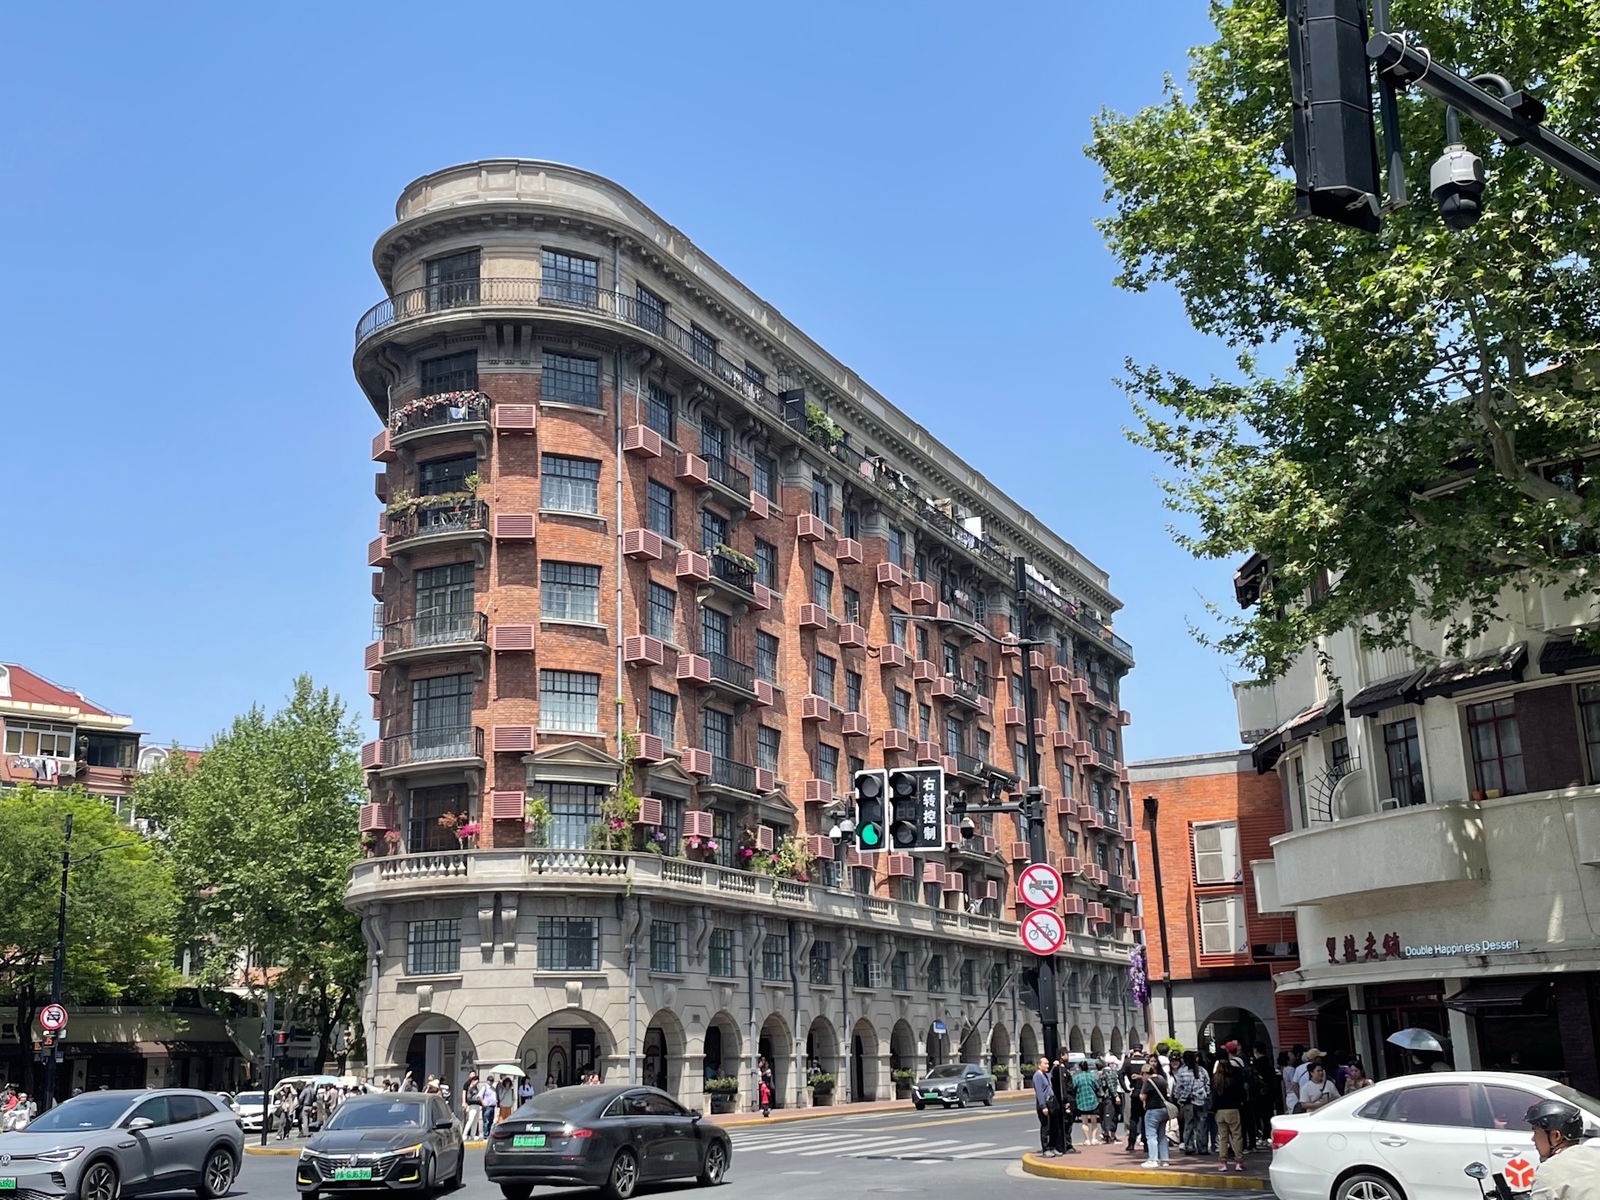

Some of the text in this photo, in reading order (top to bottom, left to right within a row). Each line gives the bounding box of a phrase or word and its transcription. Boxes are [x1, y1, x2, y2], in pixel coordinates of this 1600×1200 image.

[923, 777, 936, 840] 右转控制
[1405, 940, 1519, 956] Double Happiness Dessert
